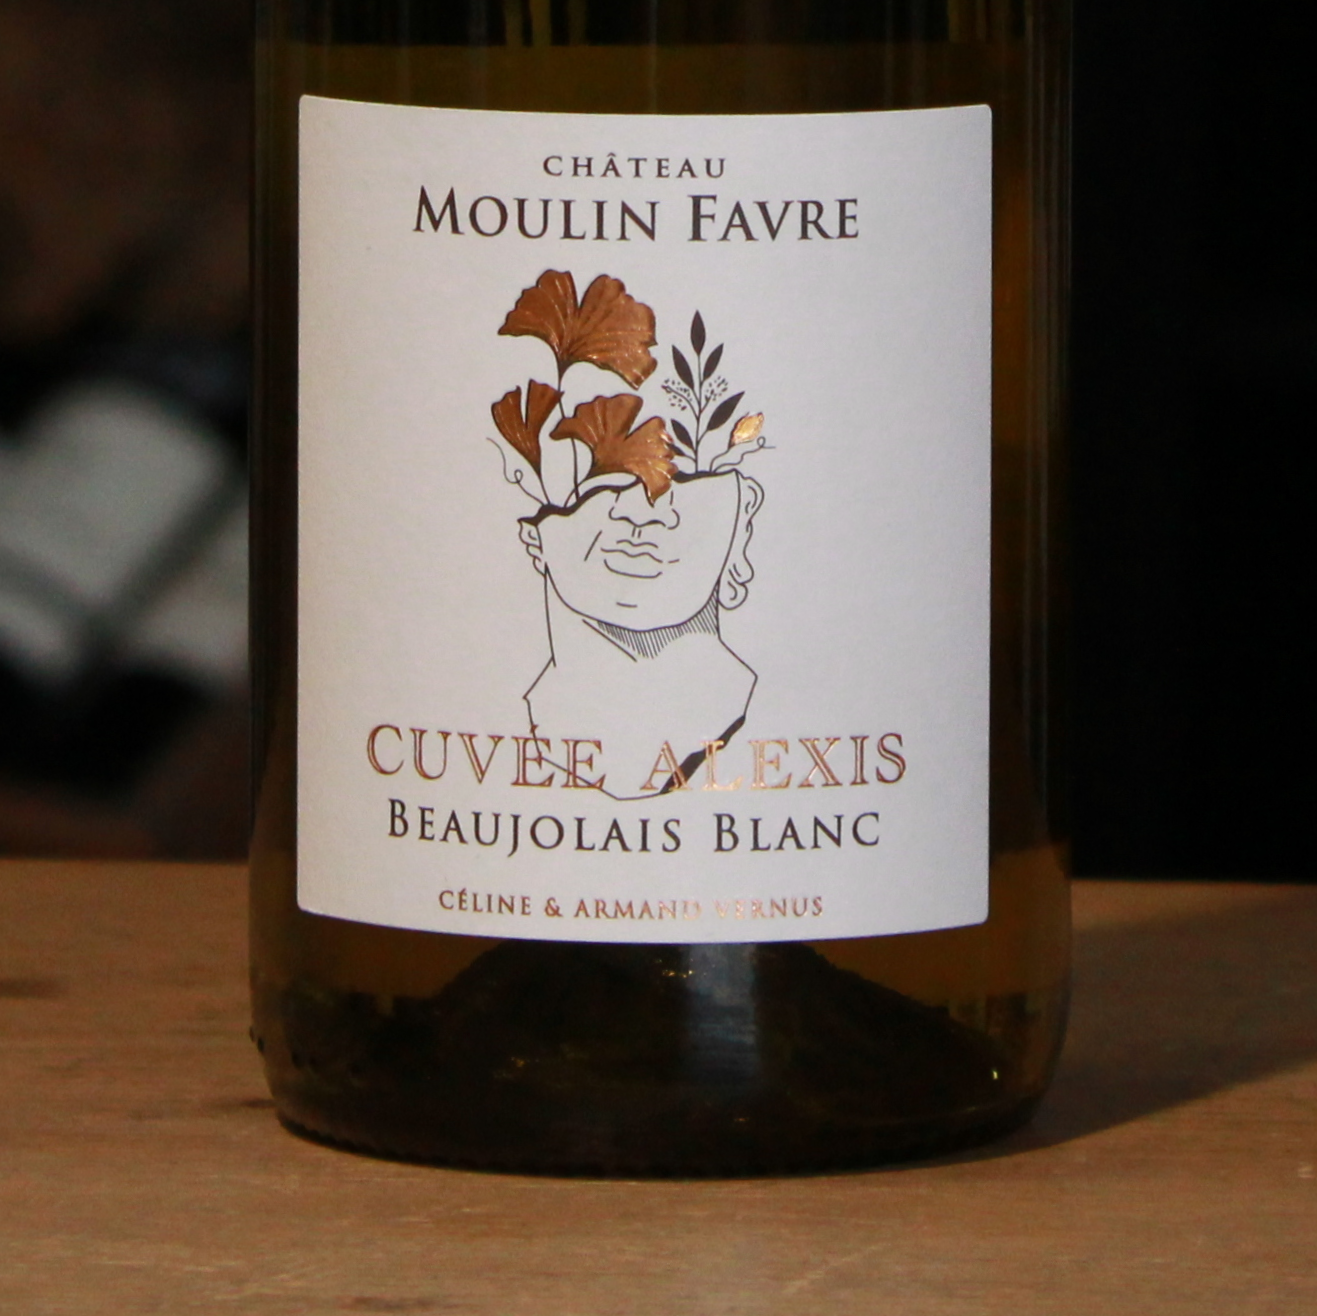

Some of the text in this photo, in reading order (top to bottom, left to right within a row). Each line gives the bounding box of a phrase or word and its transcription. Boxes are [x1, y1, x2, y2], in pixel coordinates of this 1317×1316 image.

[543, 152, 727, 179] CHÂTEAU
[413, 185, 860, 243] MOULIN FAVRE
[367, 723, 907, 792] CUVÉE ALEXIS
[388, 798, 882, 858] BEAUJOLAIS BLANC
[439, 888, 824, 920] CÉLINE & ARMAND VERNUS
